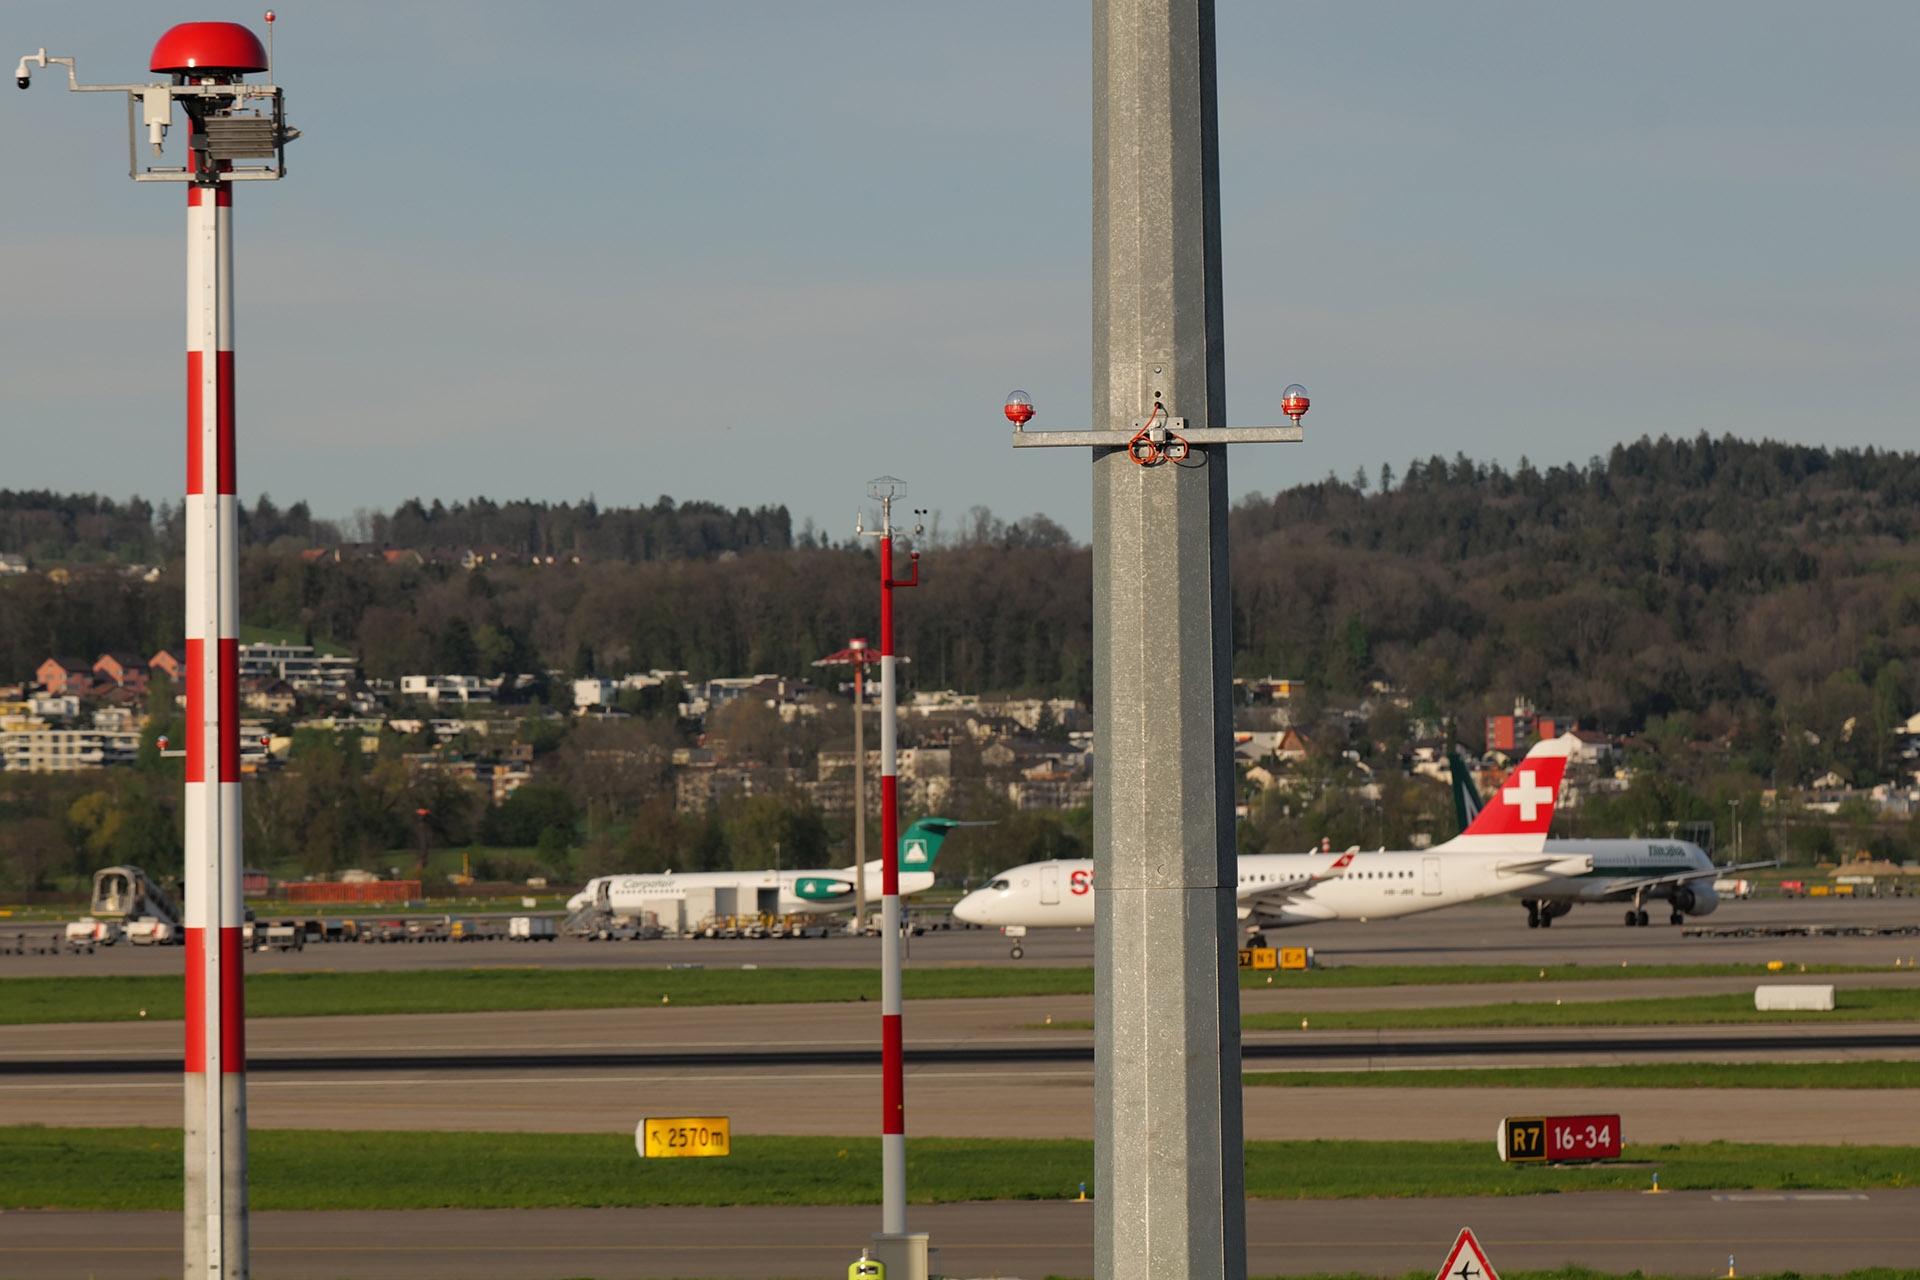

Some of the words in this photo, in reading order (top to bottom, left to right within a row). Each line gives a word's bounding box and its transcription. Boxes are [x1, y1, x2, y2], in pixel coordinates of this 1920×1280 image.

[1070, 870, 1094, 895] S
[668, 1127, 724, 1147] 2570m
[1513, 1127, 1540, 1151] R7
[1554, 1125, 1611, 1150] 16-34
